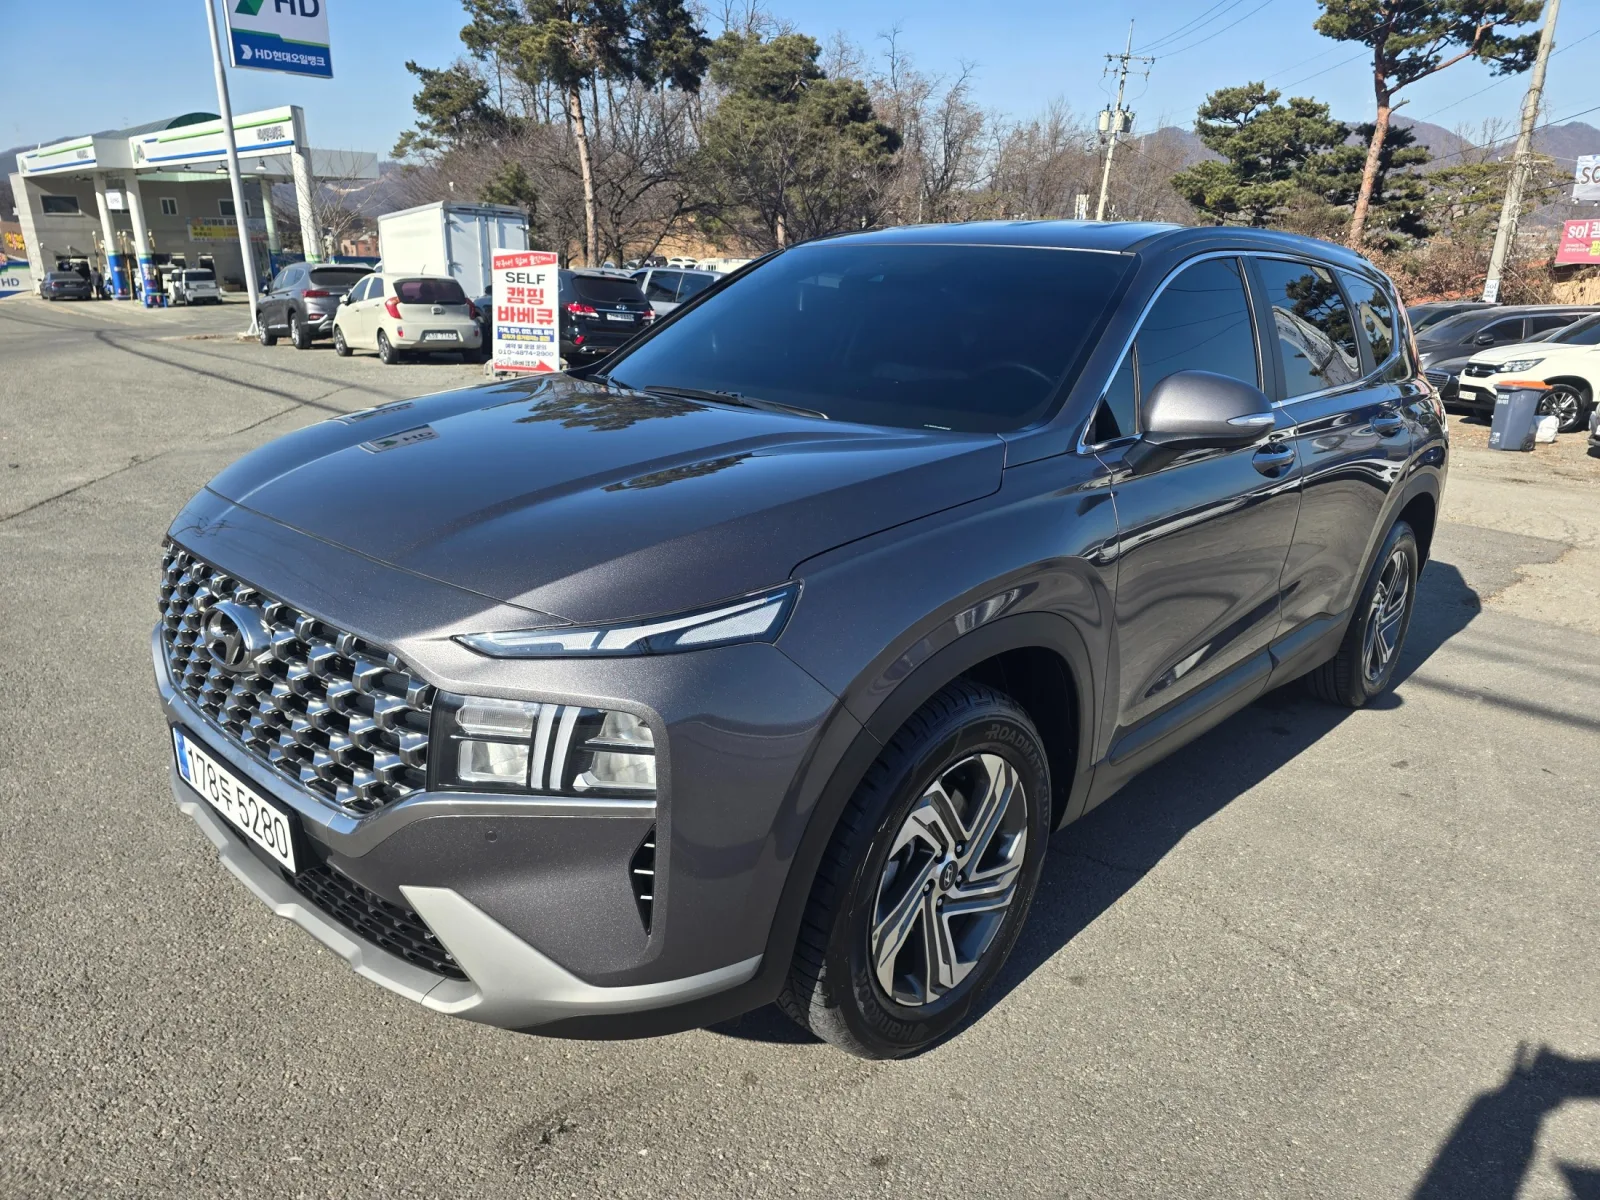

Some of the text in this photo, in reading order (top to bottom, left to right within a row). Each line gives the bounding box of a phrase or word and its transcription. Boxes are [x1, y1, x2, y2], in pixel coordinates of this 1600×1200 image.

[274, 0, 320, 18] HD
[254, 48, 326, 67] HD현대오일뱅크
[1, 277, 20, 287] HD
[505, 271, 546, 285] SELF
[506, 286, 544, 305] 캠핑
[497, 305, 554, 325] 바베큐
